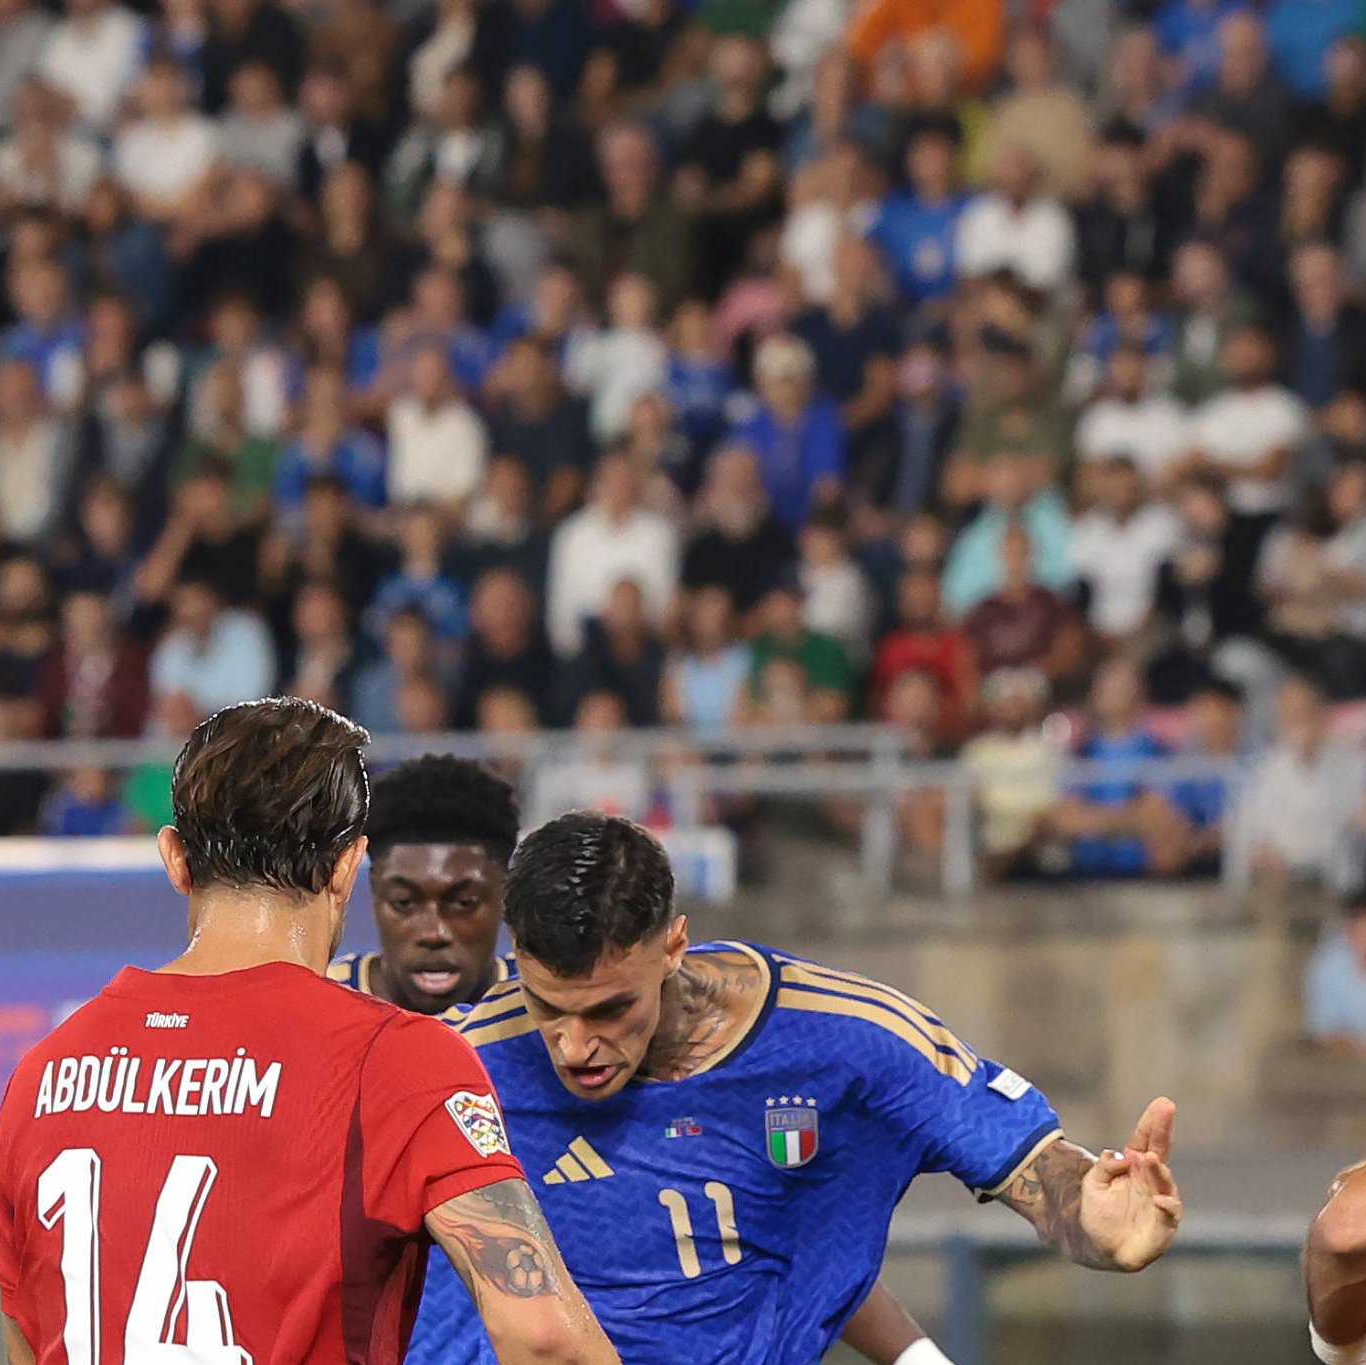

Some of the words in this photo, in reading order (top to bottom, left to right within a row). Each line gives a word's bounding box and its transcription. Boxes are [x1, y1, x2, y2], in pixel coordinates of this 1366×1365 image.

[144, 1011, 190, 1029] TÜRKİYE
[33, 1045, 283, 1120] ABDÜLKERİM
[657, 1180, 743, 1280] 11
